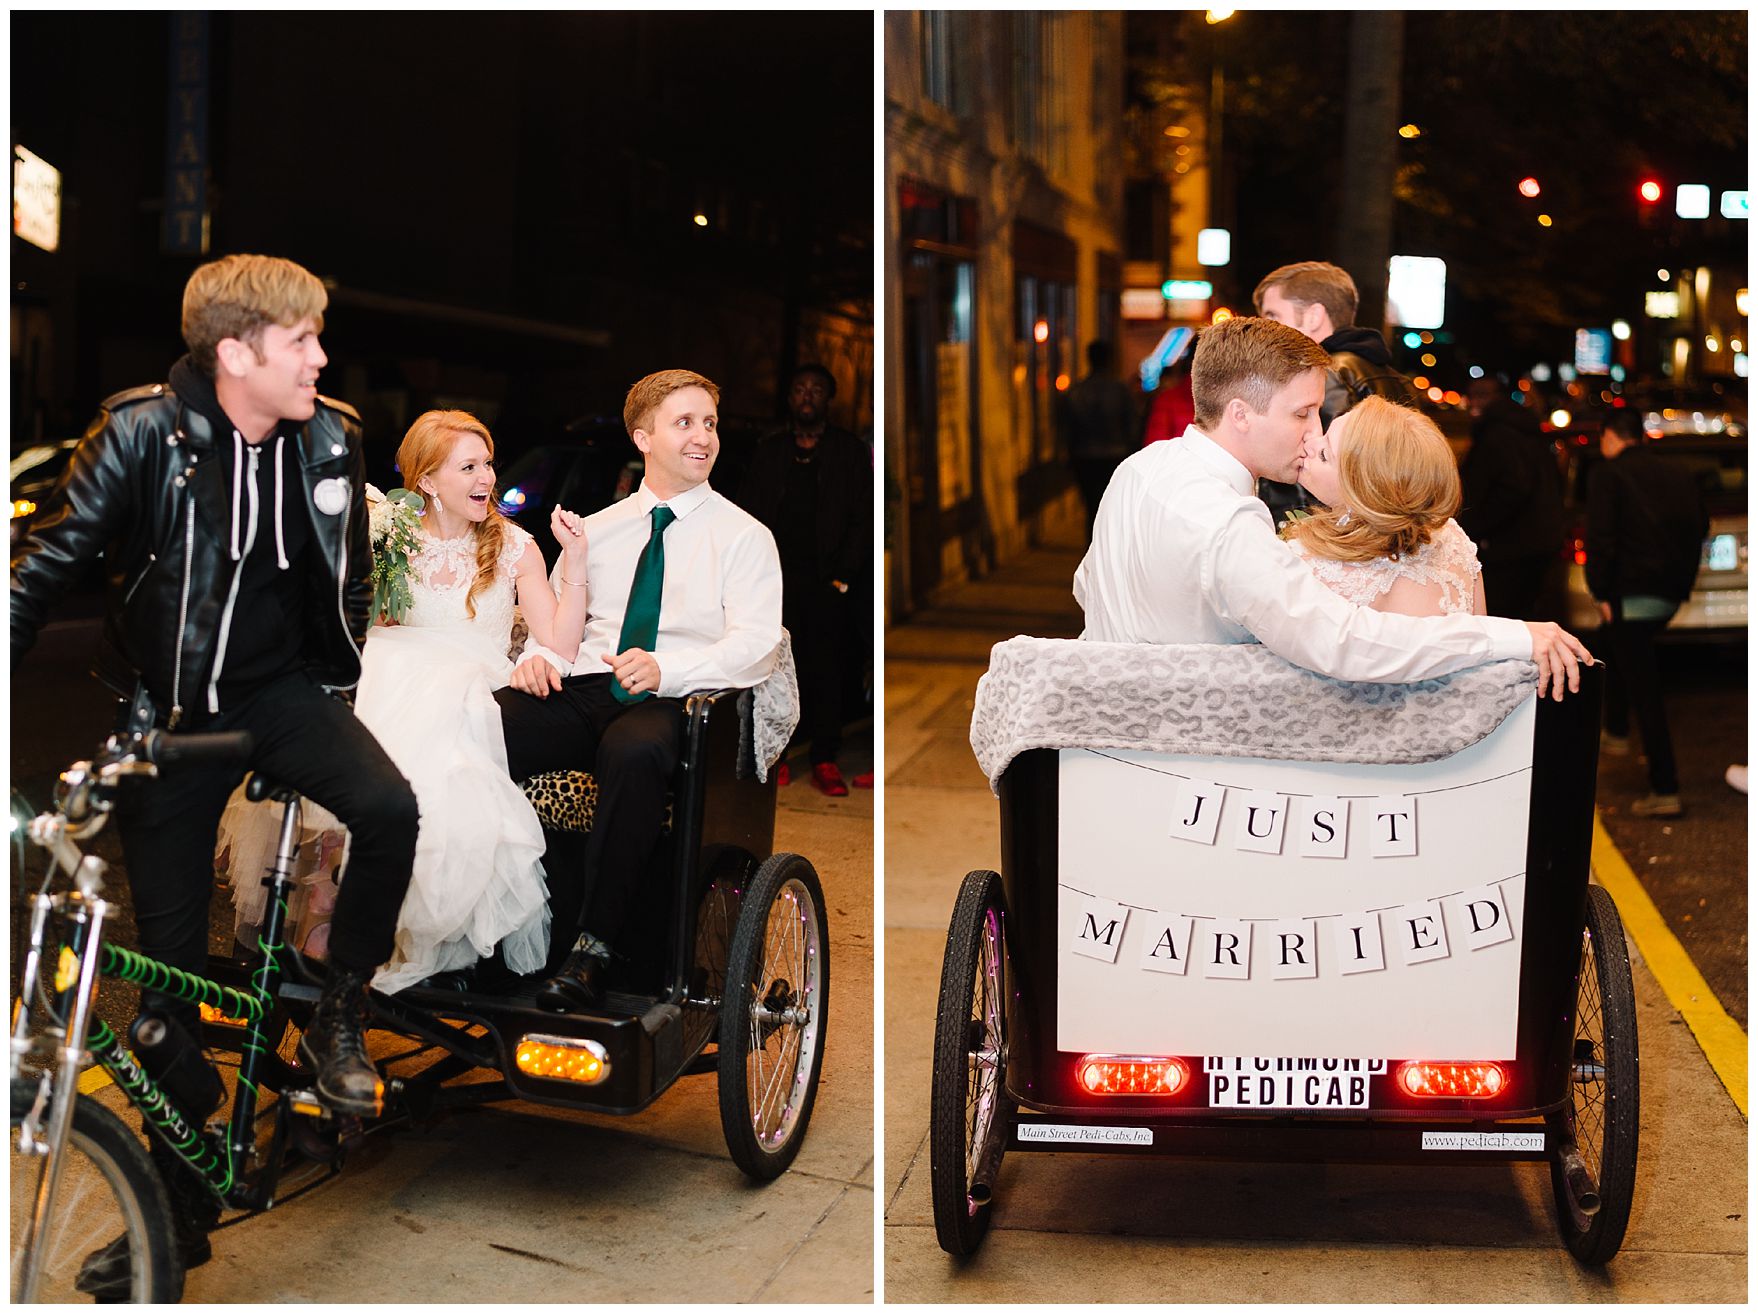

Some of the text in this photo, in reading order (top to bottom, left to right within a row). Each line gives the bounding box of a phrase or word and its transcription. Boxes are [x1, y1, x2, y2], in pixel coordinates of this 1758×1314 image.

[1183, 795, 1408, 844] JUST
[1077, 899, 1502, 966] MARRIED
[1213, 1075, 1365, 1106] PEDICAB
[1020, 1127, 1047, 1138] Main
[1049, 1128, 1077, 1139] Street
[1423, 1133, 1543, 1150] www.pedicab.com
